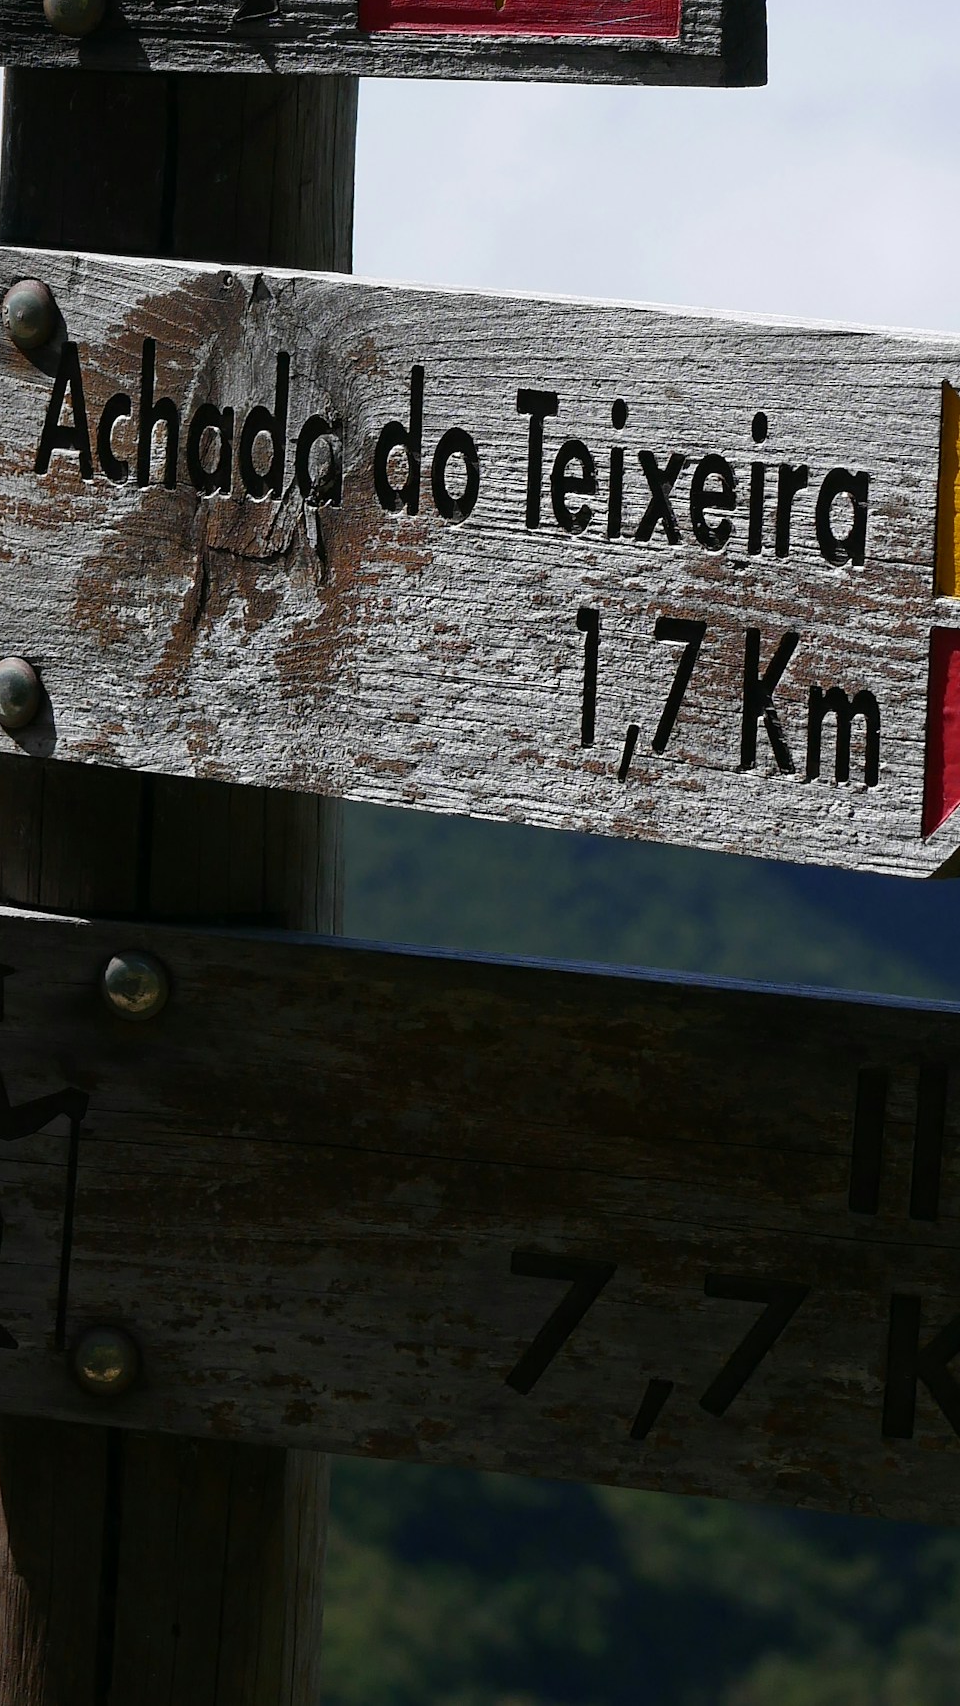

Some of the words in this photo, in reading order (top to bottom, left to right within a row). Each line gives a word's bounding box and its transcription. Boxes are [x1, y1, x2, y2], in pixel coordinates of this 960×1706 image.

[36, 338, 343, 507] Achada
[374, 365, 480, 524] do
[517, 388, 870, 567] Teixeira
[577, 608, 707, 782] 1,7
[741, 627, 880, 787] Km
[505, 1252, 811, 1440] 7,7
